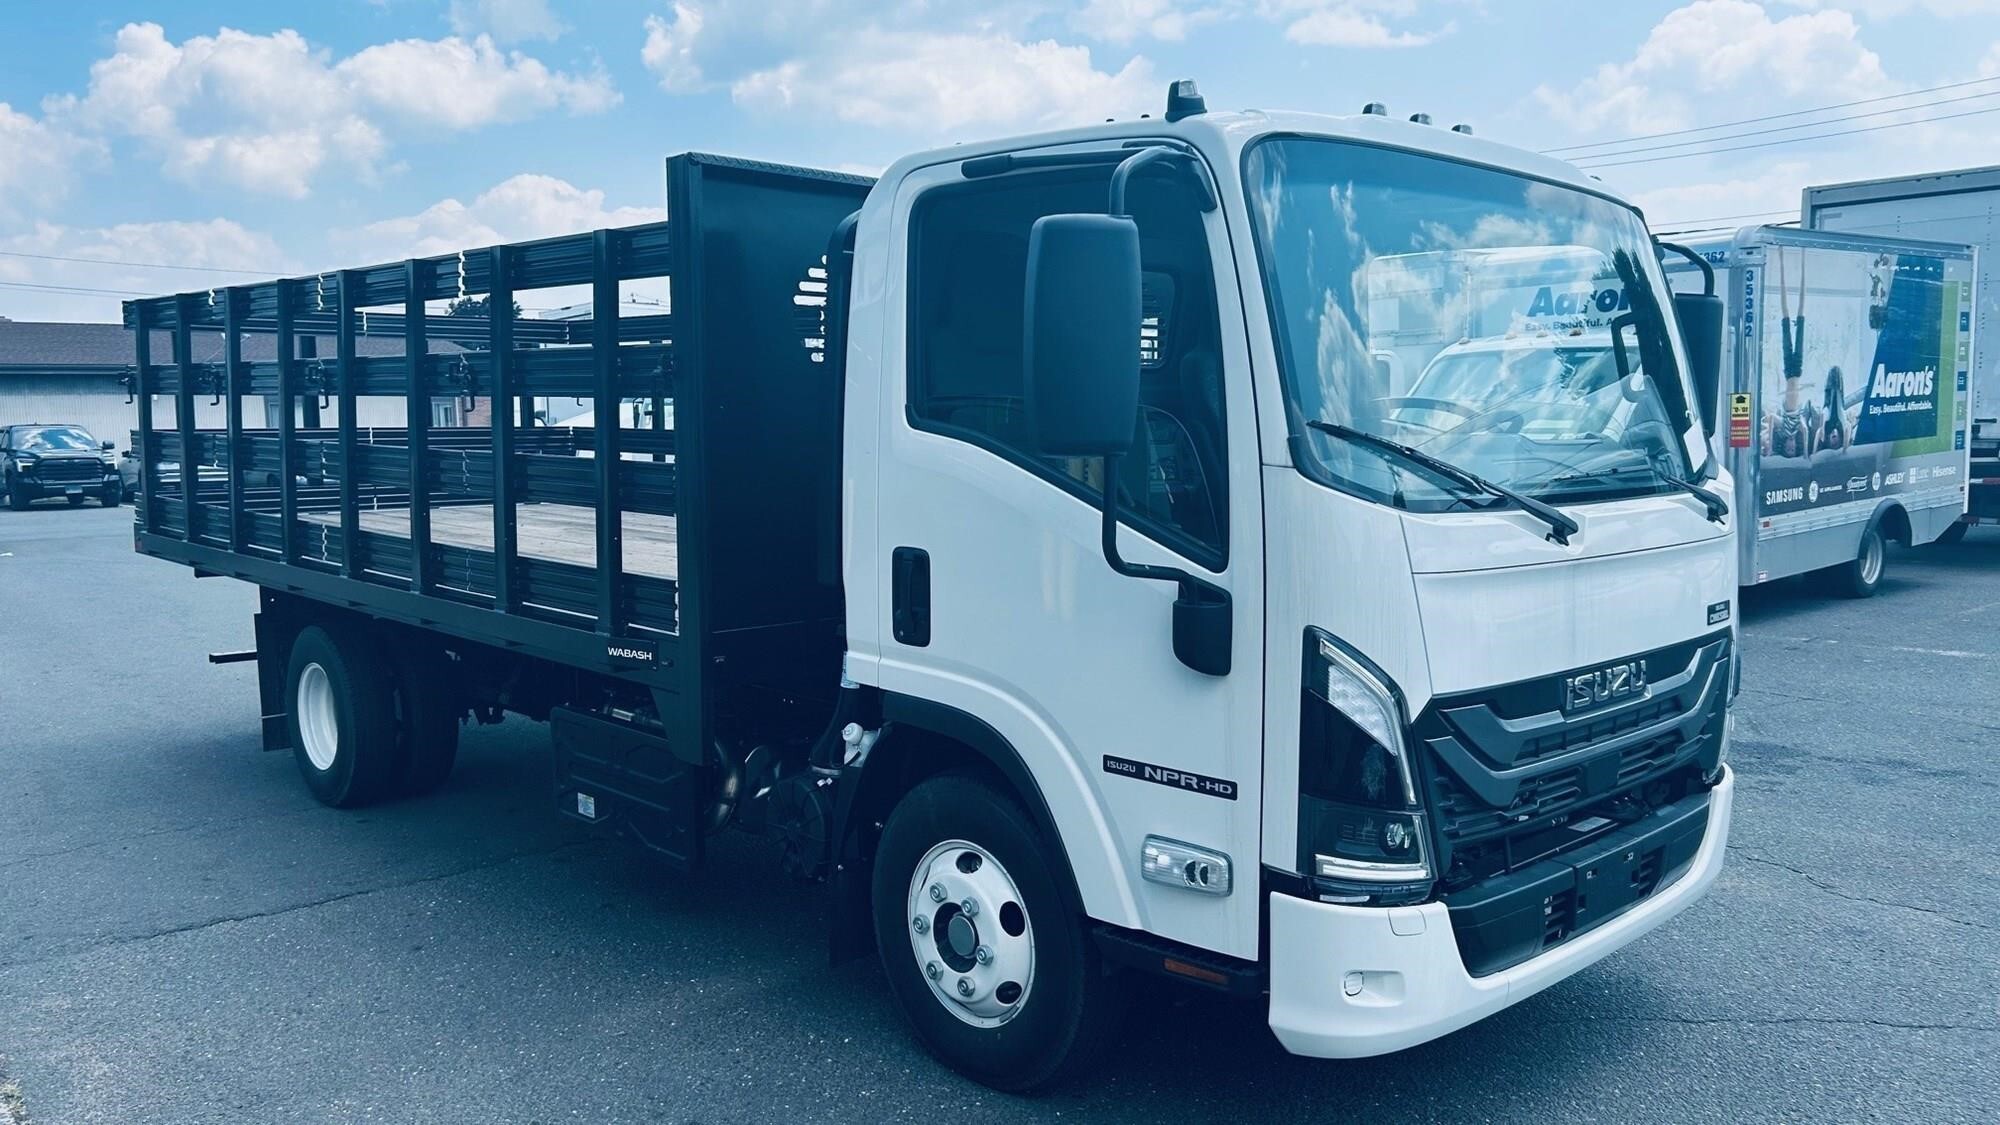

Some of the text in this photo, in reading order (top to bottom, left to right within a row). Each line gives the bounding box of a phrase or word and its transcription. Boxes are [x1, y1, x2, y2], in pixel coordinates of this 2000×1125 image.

[1744, 270, 1754, 337] 35362
[1870, 364, 1934, 398] Aaron's
[1766, 487, 1804, 505] SAMSUNG
[1932, 466, 1957, 478] Hisense
[607, 646, 653, 661] WABASH
[1565, 660, 1646, 710] ISUZU
[1107, 760, 1232, 794] ISUZU NPR-HD
